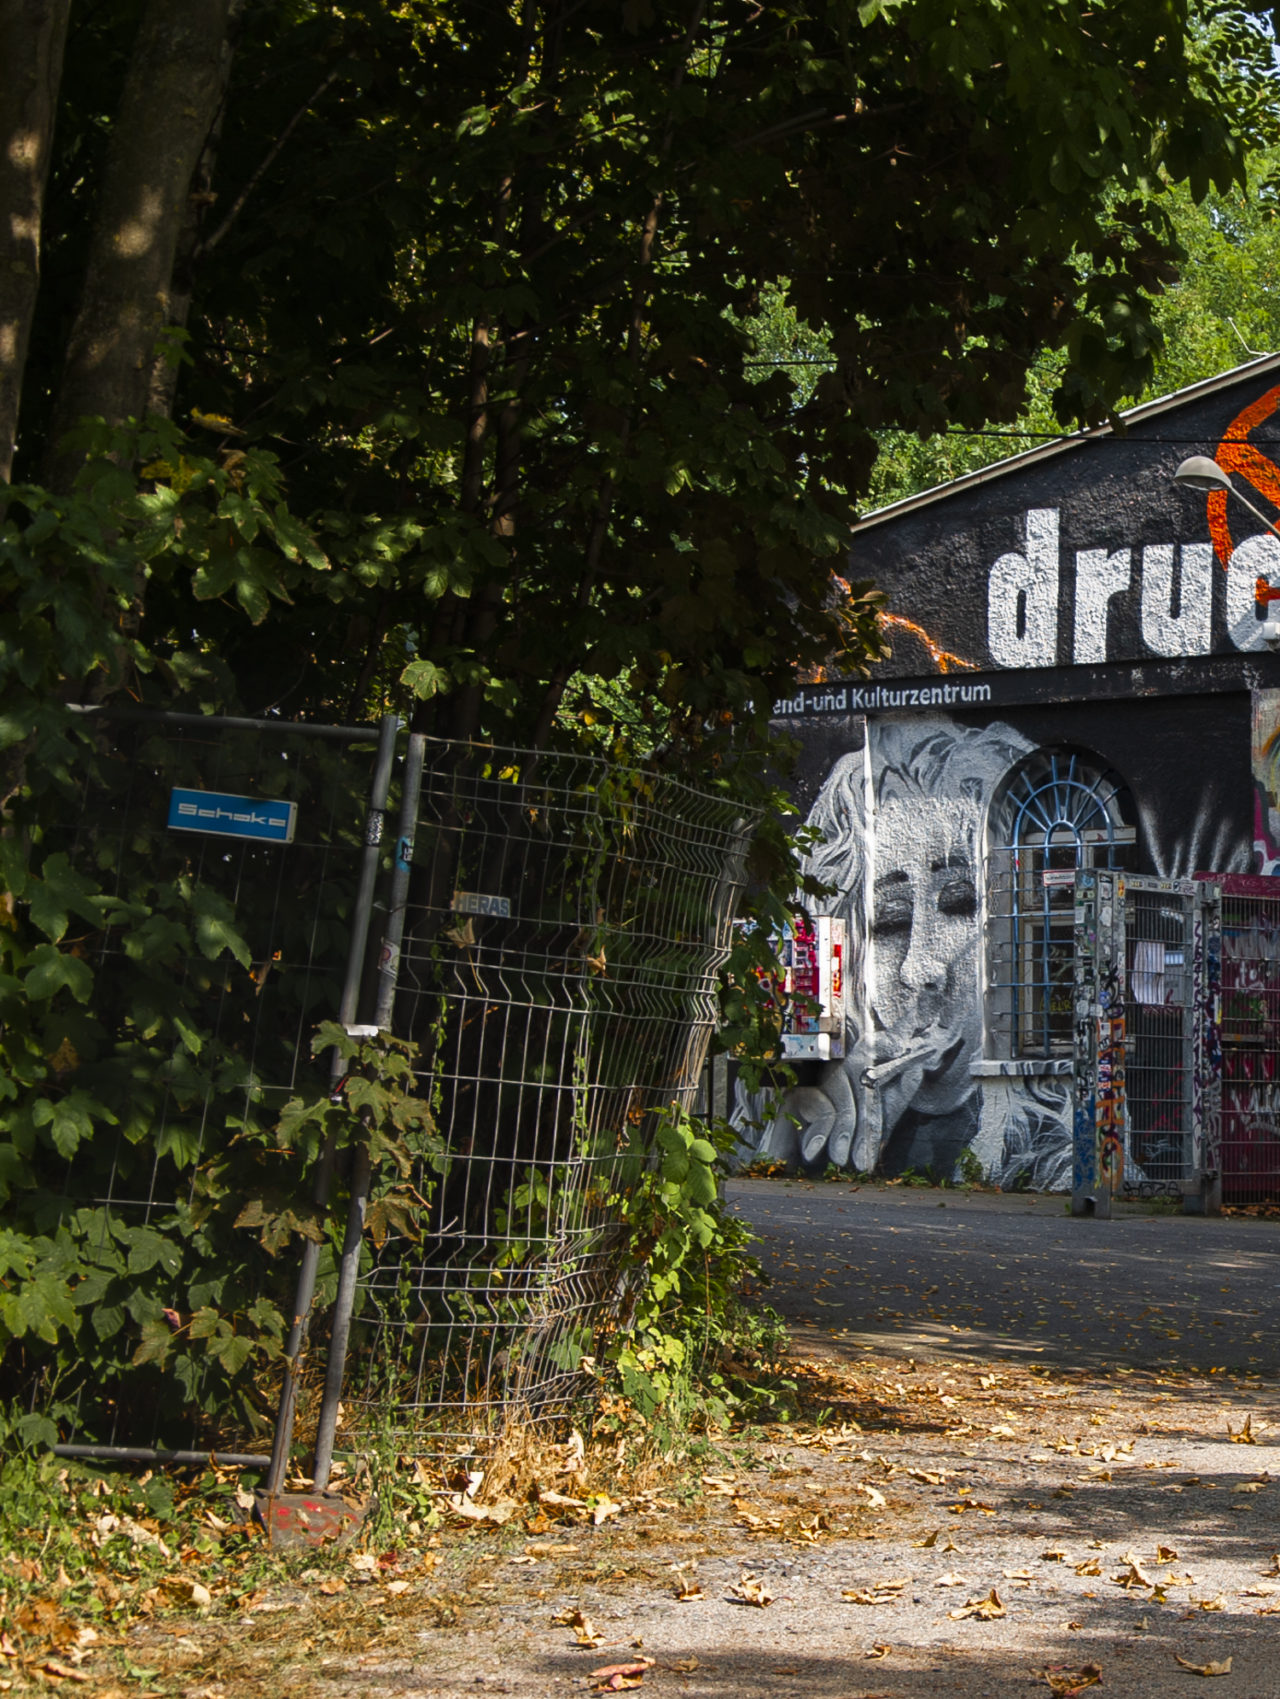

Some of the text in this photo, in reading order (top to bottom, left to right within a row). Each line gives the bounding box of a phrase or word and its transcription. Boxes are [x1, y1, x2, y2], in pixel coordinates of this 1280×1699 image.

[744, 683, 991, 715] end-und Kulturzentrum
[456, 894, 509, 916] HERAS
